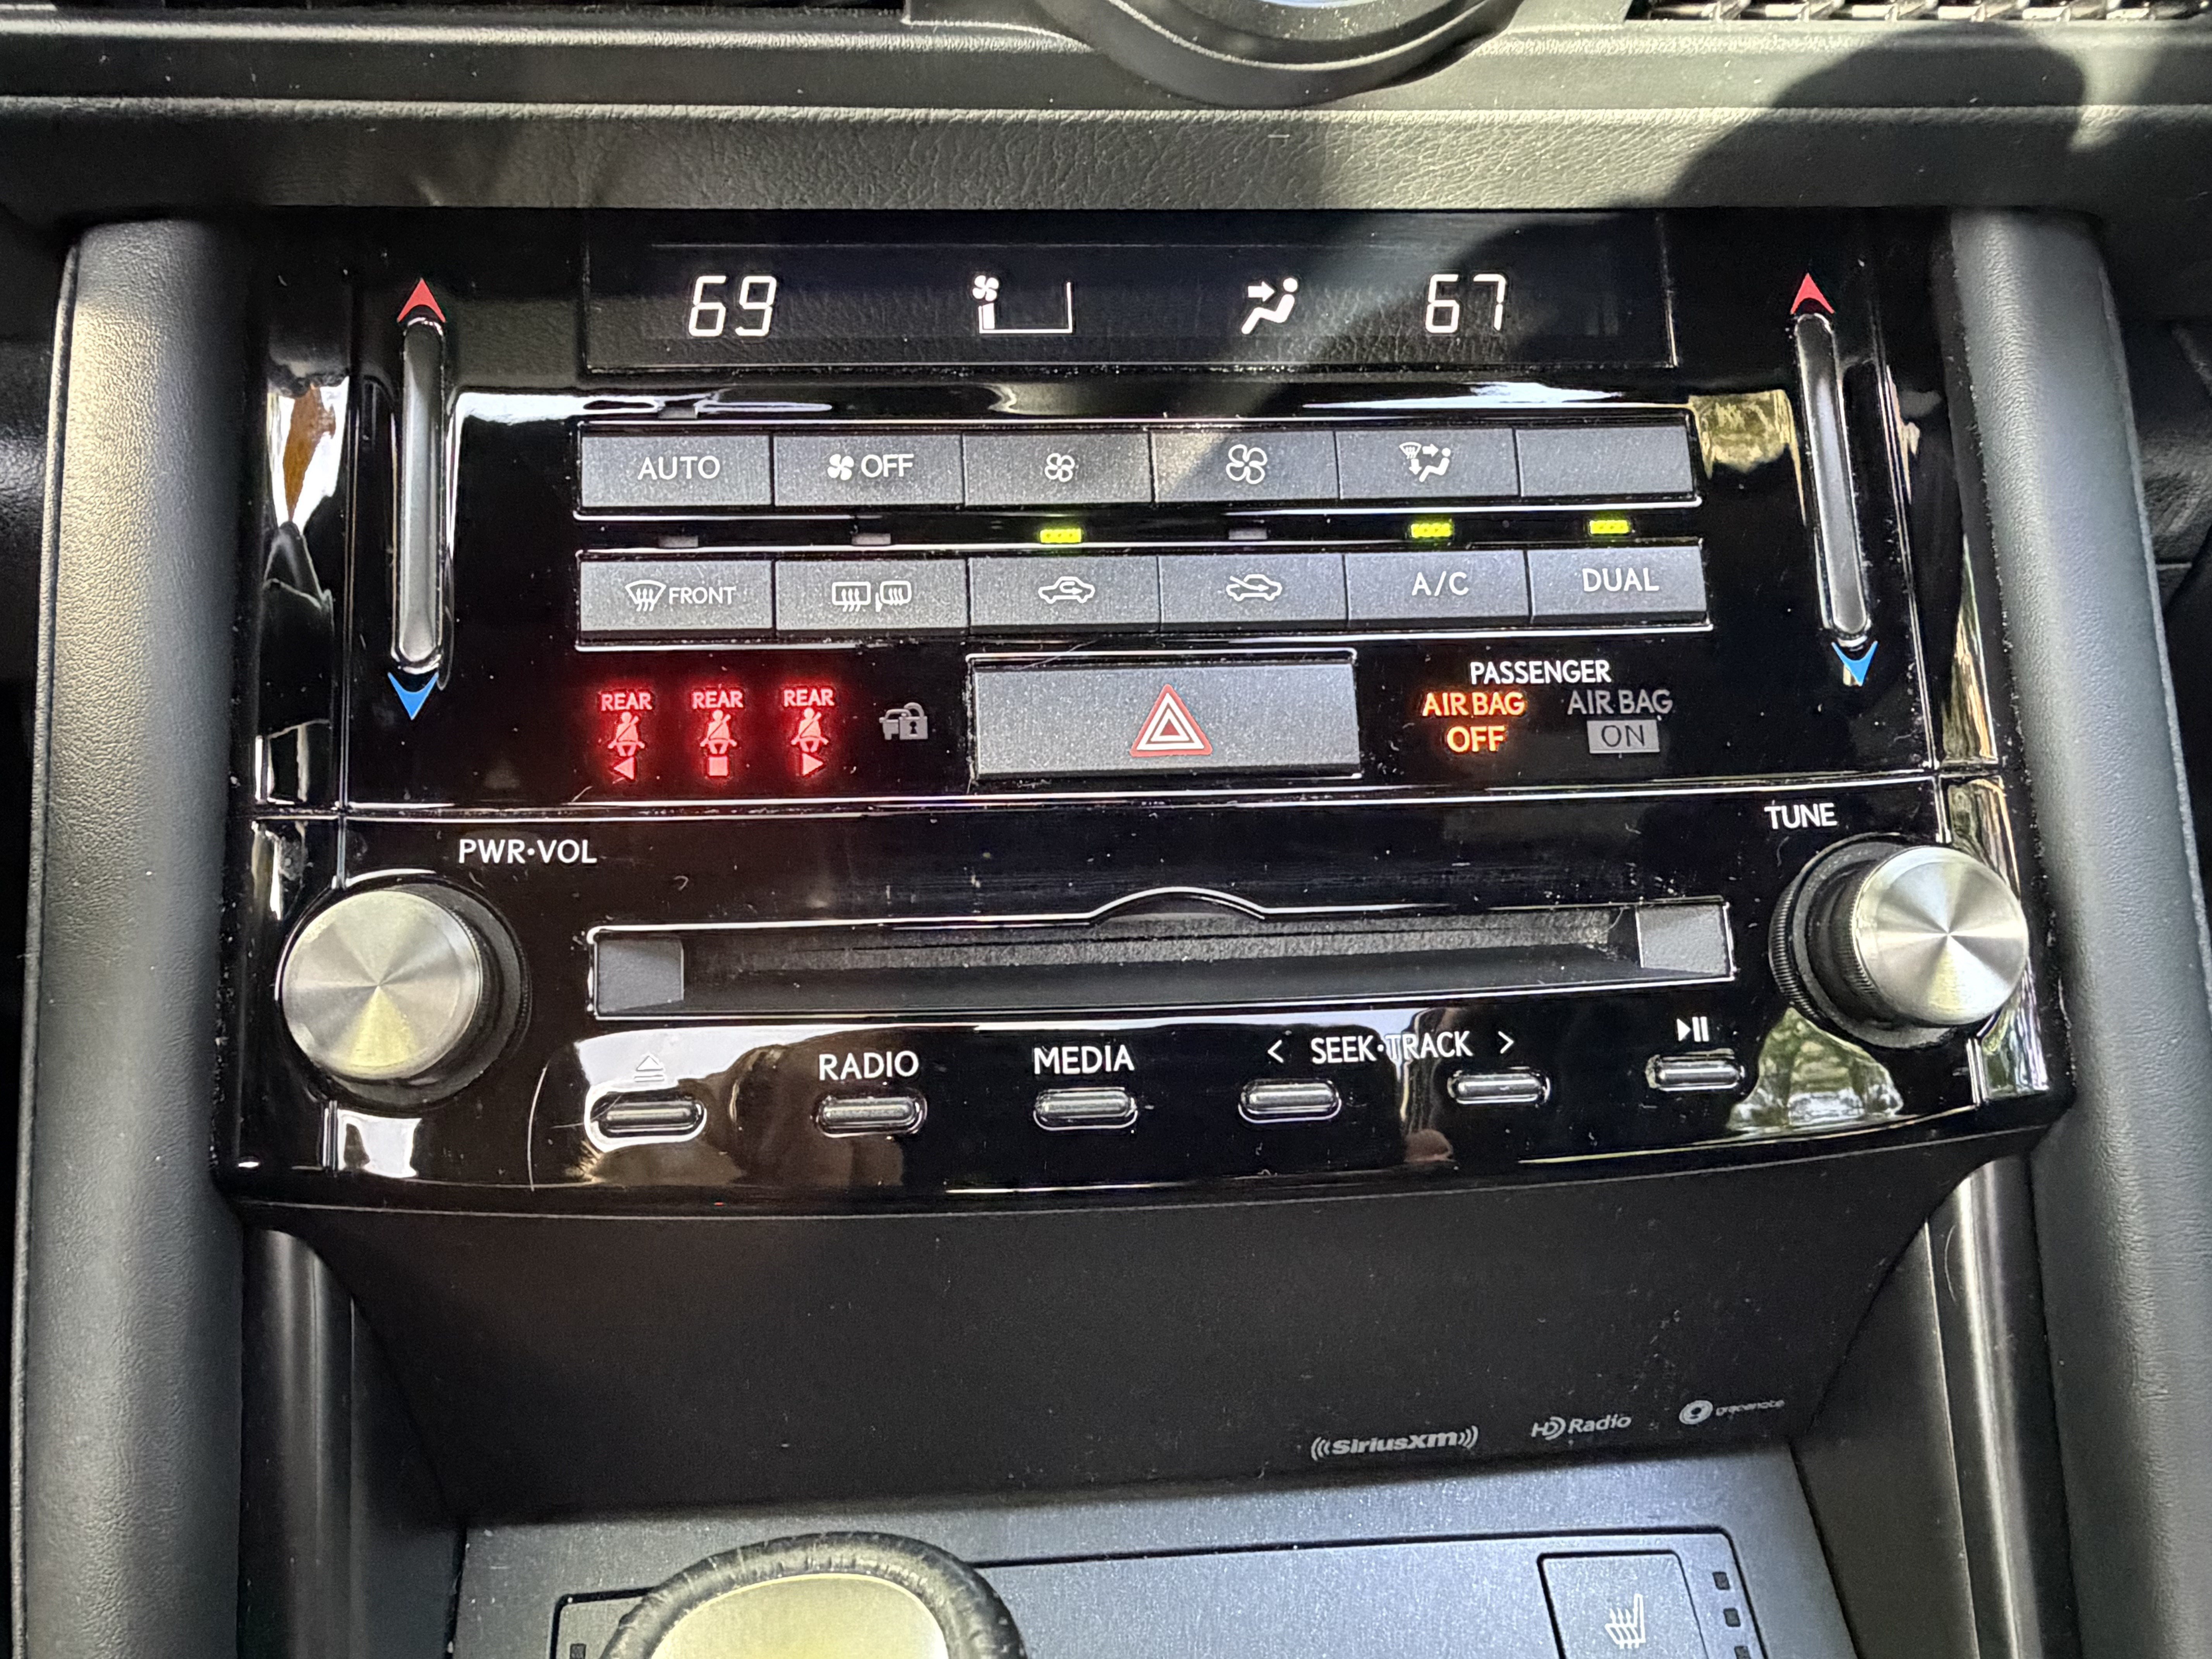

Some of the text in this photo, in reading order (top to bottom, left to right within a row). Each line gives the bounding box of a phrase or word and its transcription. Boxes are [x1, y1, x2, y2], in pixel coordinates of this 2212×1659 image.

[688, 275, 777, 337] 69
[1425, 274, 1506, 333] 67
[637, 455, 720, 480] AUTO
[860, 453, 914, 477] OFF
[1412, 570, 1469, 596] A/C
[1582, 567, 1660, 592] DUAL
[669, 586, 737, 605] FRONT
[1470, 659, 1612, 685] PASSENGER
[601, 692, 653, 711] REAR
[692, 690, 744, 709] REAR
[784, 689, 835, 707] REAR
[1447, 725, 1506, 752] OFF
[1601, 725, 1645, 747] ON
[1764, 804, 1838, 829] TUNE
[819, 1050, 919, 1080] RADIO
[1034, 1044, 1135, 1074] MEDIA
[1531, 1413, 1632, 1441] HD Radio
